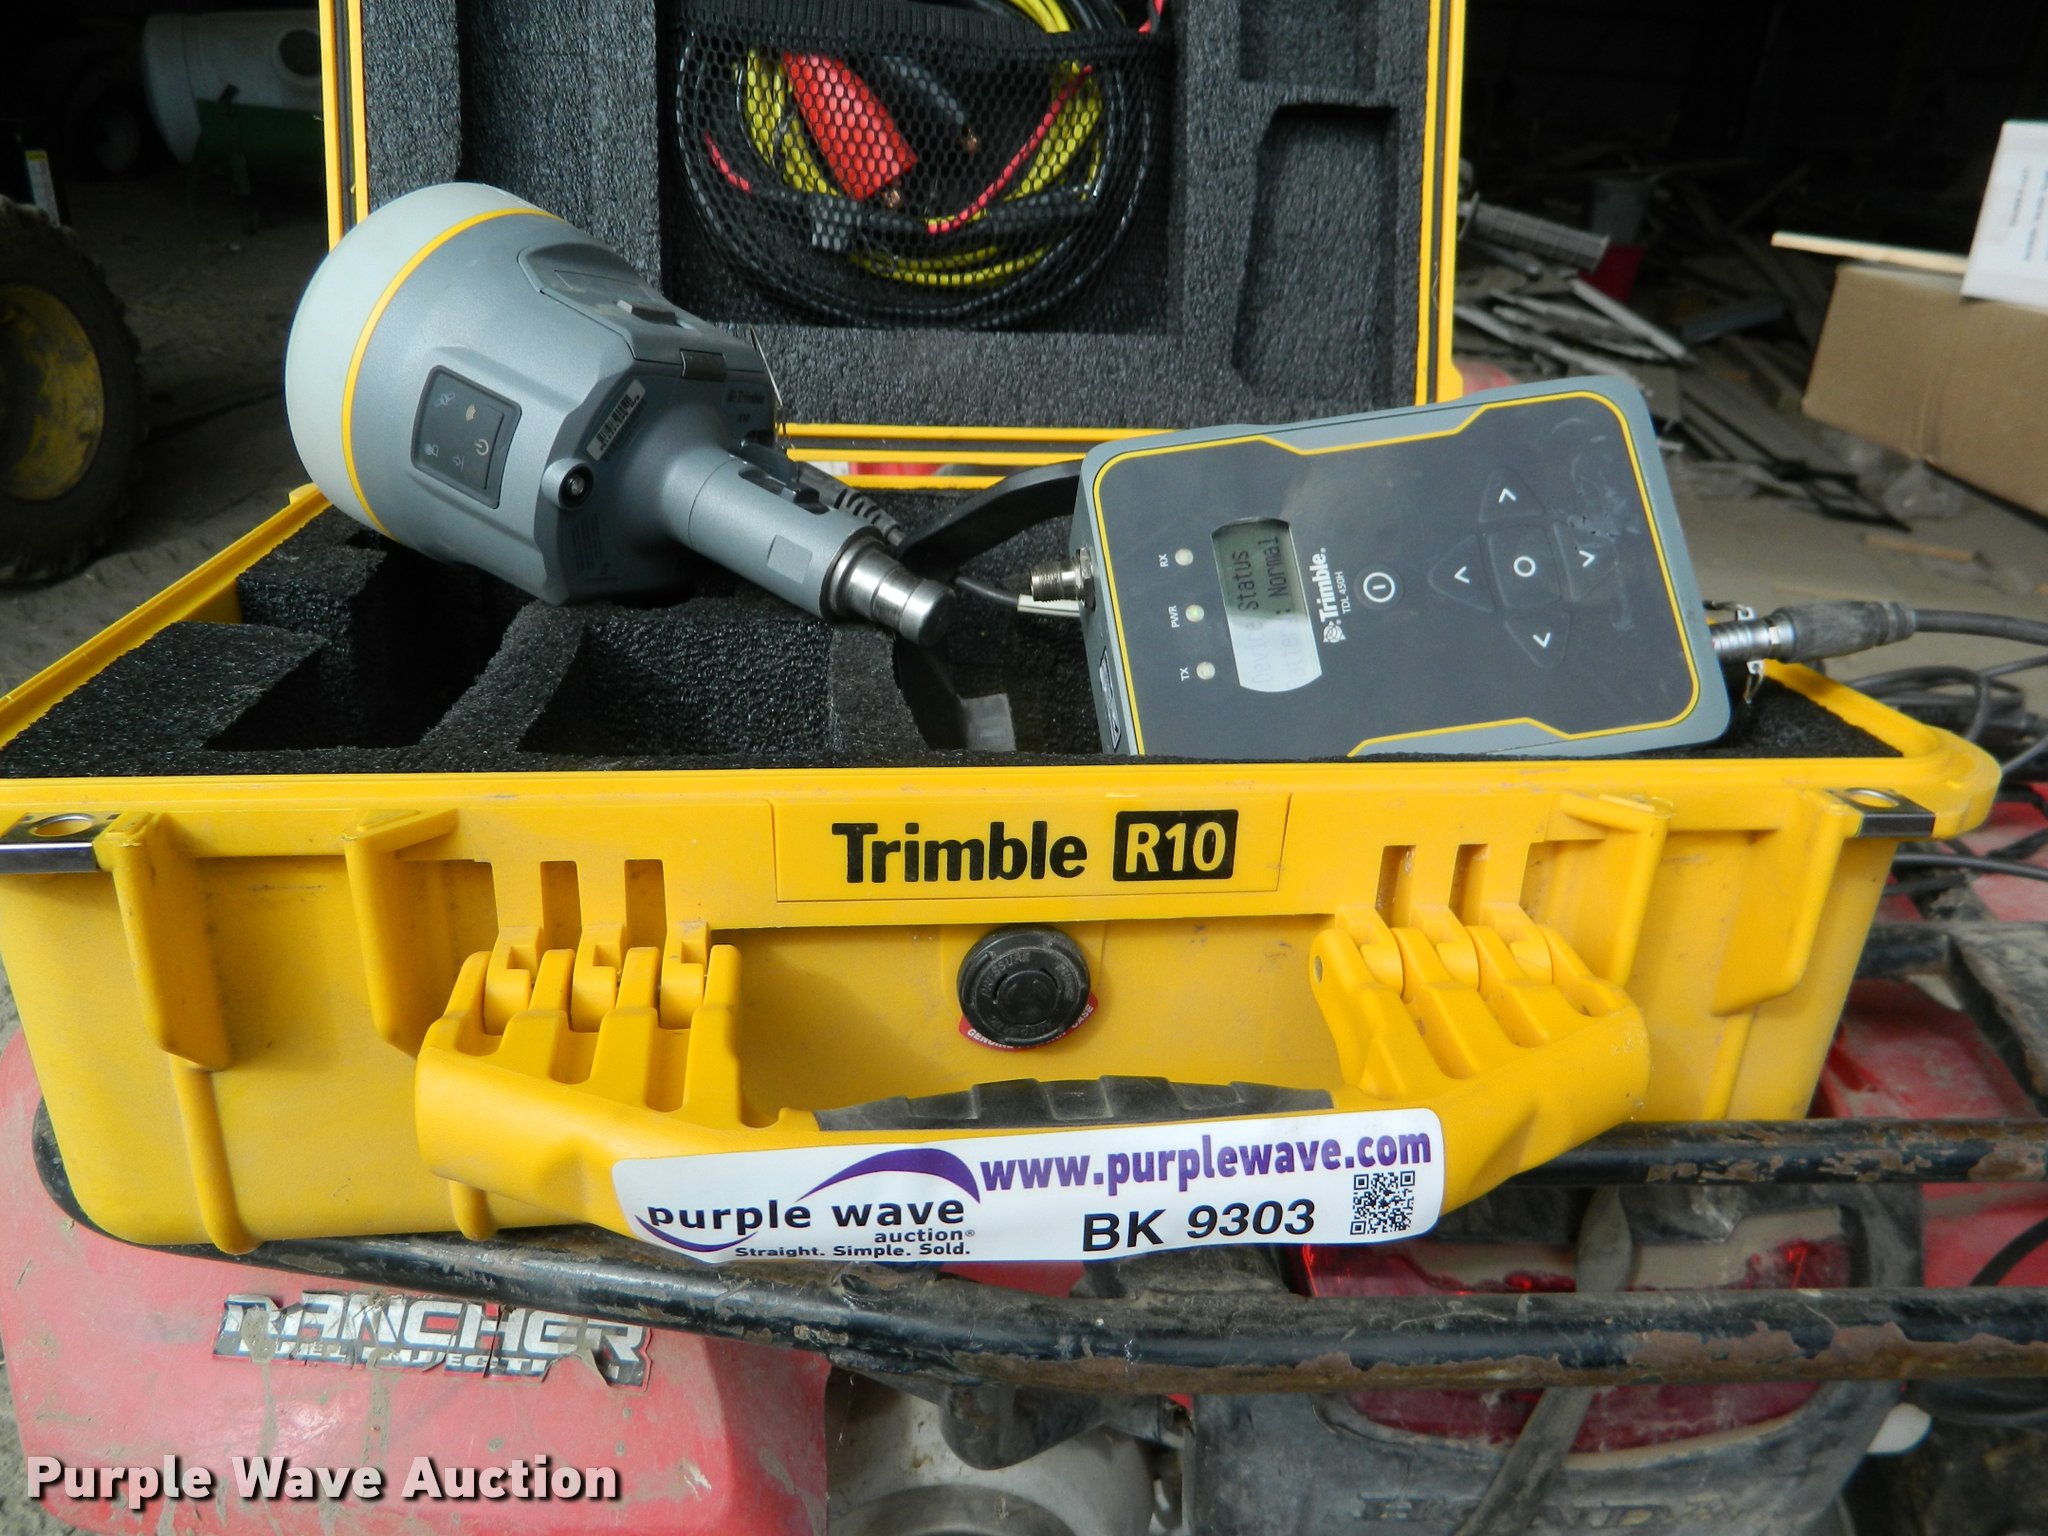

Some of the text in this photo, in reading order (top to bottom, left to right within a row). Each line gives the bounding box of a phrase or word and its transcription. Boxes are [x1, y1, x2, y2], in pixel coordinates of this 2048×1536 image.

[1159, 553, 1168, 567] RX
[1231, 550, 1259, 612] Status
[1258, 536, 1290, 598] Normal
[1334, 571, 1352, 614] TDL 450H
[1168, 605, 1180, 628] PWR
[1179, 667, 1190, 681] TX
[831, 820, 1227, 883] Trimble R10
[980, 1131, 1432, 1197] www.purplewave.com
[647, 1199, 965, 1236] purple wave
[1082, 1199, 1316, 1253] BK 9303
[734, 1241, 971, 1259] Straight. Simple. Sold.
